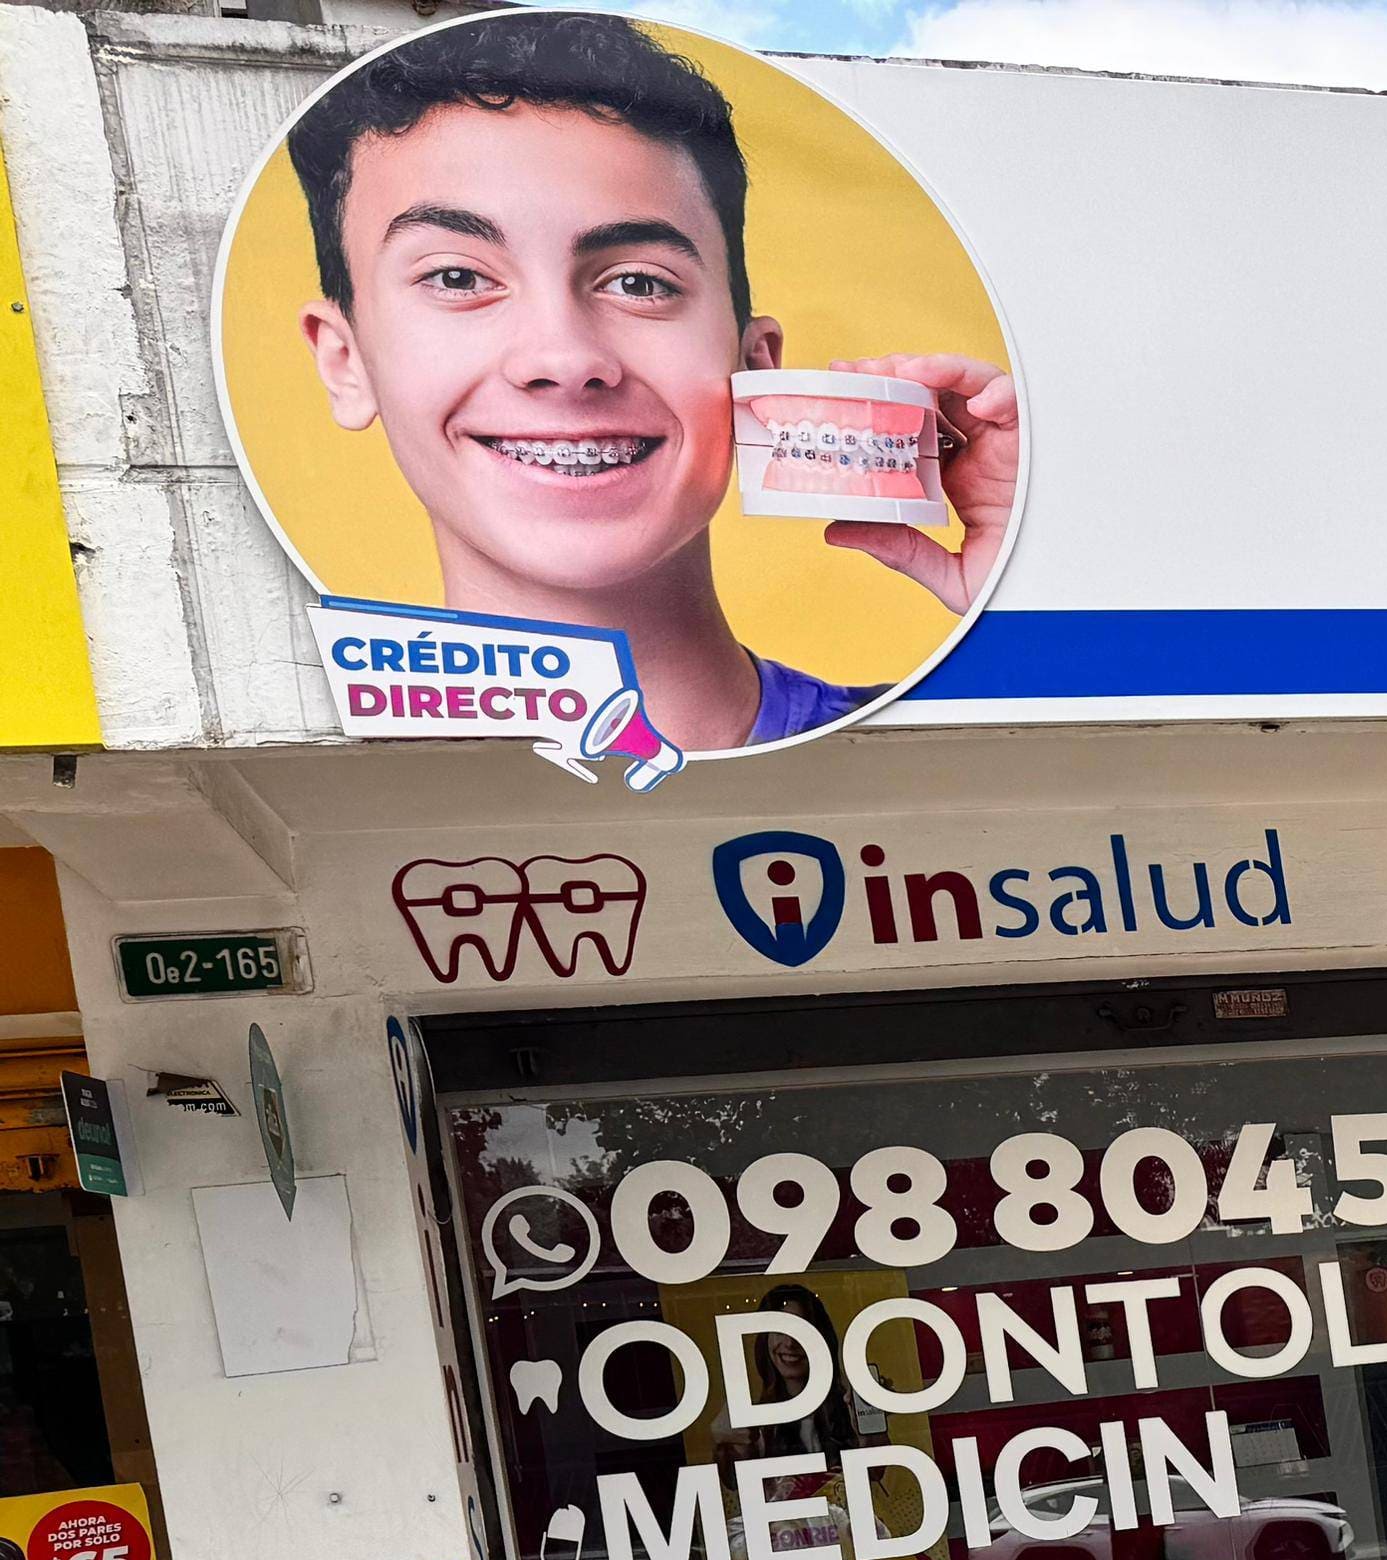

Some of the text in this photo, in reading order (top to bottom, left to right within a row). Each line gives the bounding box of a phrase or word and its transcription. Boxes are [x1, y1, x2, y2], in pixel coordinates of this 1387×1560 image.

[331, 630, 571, 679] CRÉDITO
[348, 682, 588, 723] DIRECTO
[860, 829, 1292, 945] insalud
[610, 1145, 958, 1285] 098
[47, 1522, 122, 1543] DOS PARES
[58, 1515, 107, 1531] AHORA
[53, 1540, 82, 1552] POR
